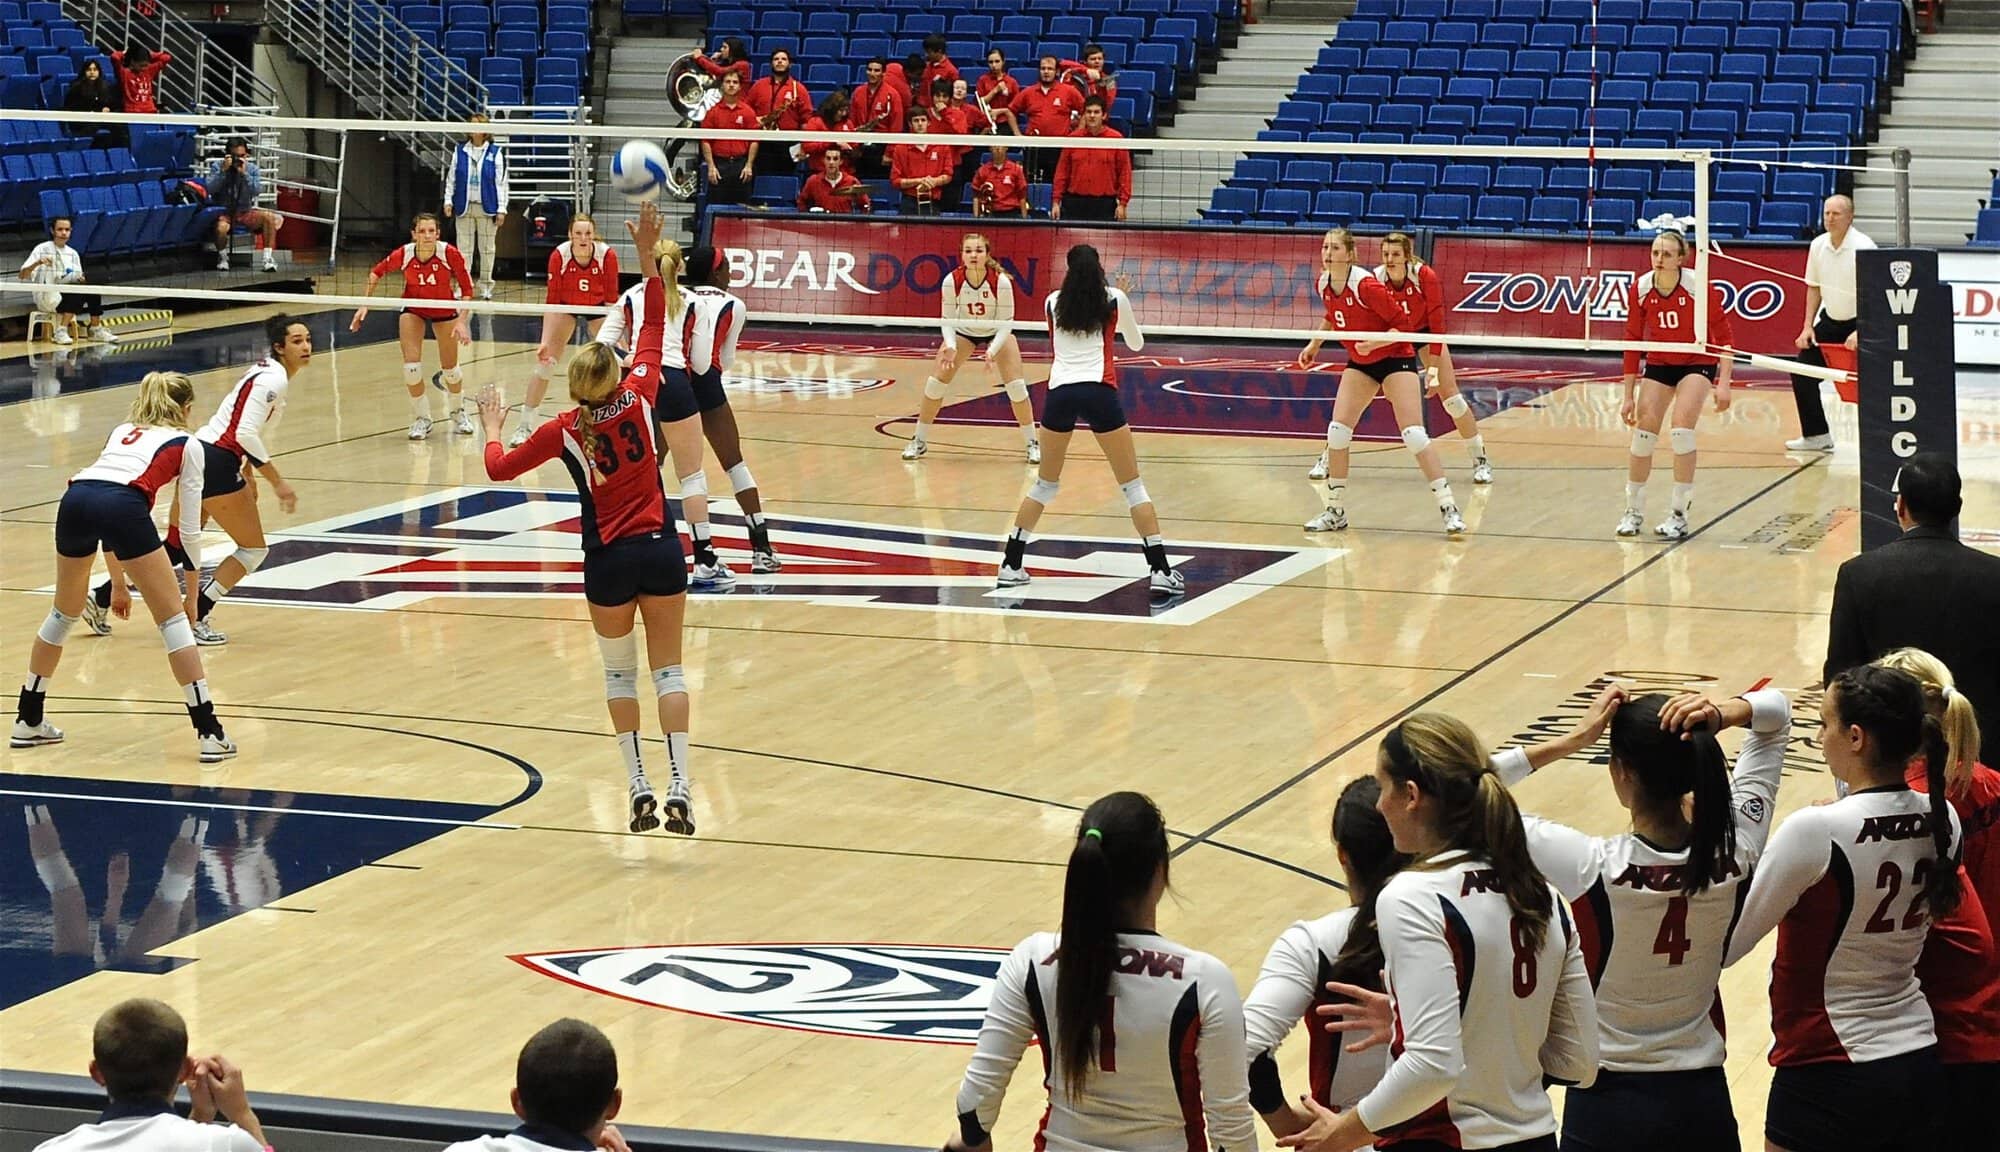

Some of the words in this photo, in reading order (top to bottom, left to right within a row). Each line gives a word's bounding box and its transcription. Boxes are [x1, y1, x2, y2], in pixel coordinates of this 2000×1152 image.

[417, 273, 437, 286] 14
[723, 248, 880, 295] BEAR
[867, 253, 1038, 297] DON
[578, 279, 590, 292] 6
[967, 302, 986, 316] 13
[1334, 310, 1346, 328] 9
[1657, 310, 1679, 329] 10
[121, 426, 149, 446] 5
[594, 419, 645, 475] 33
[1864, 857, 1931, 933] 22
[1652, 896, 1692, 966] 4
[1510, 913, 1537, 999] 8
